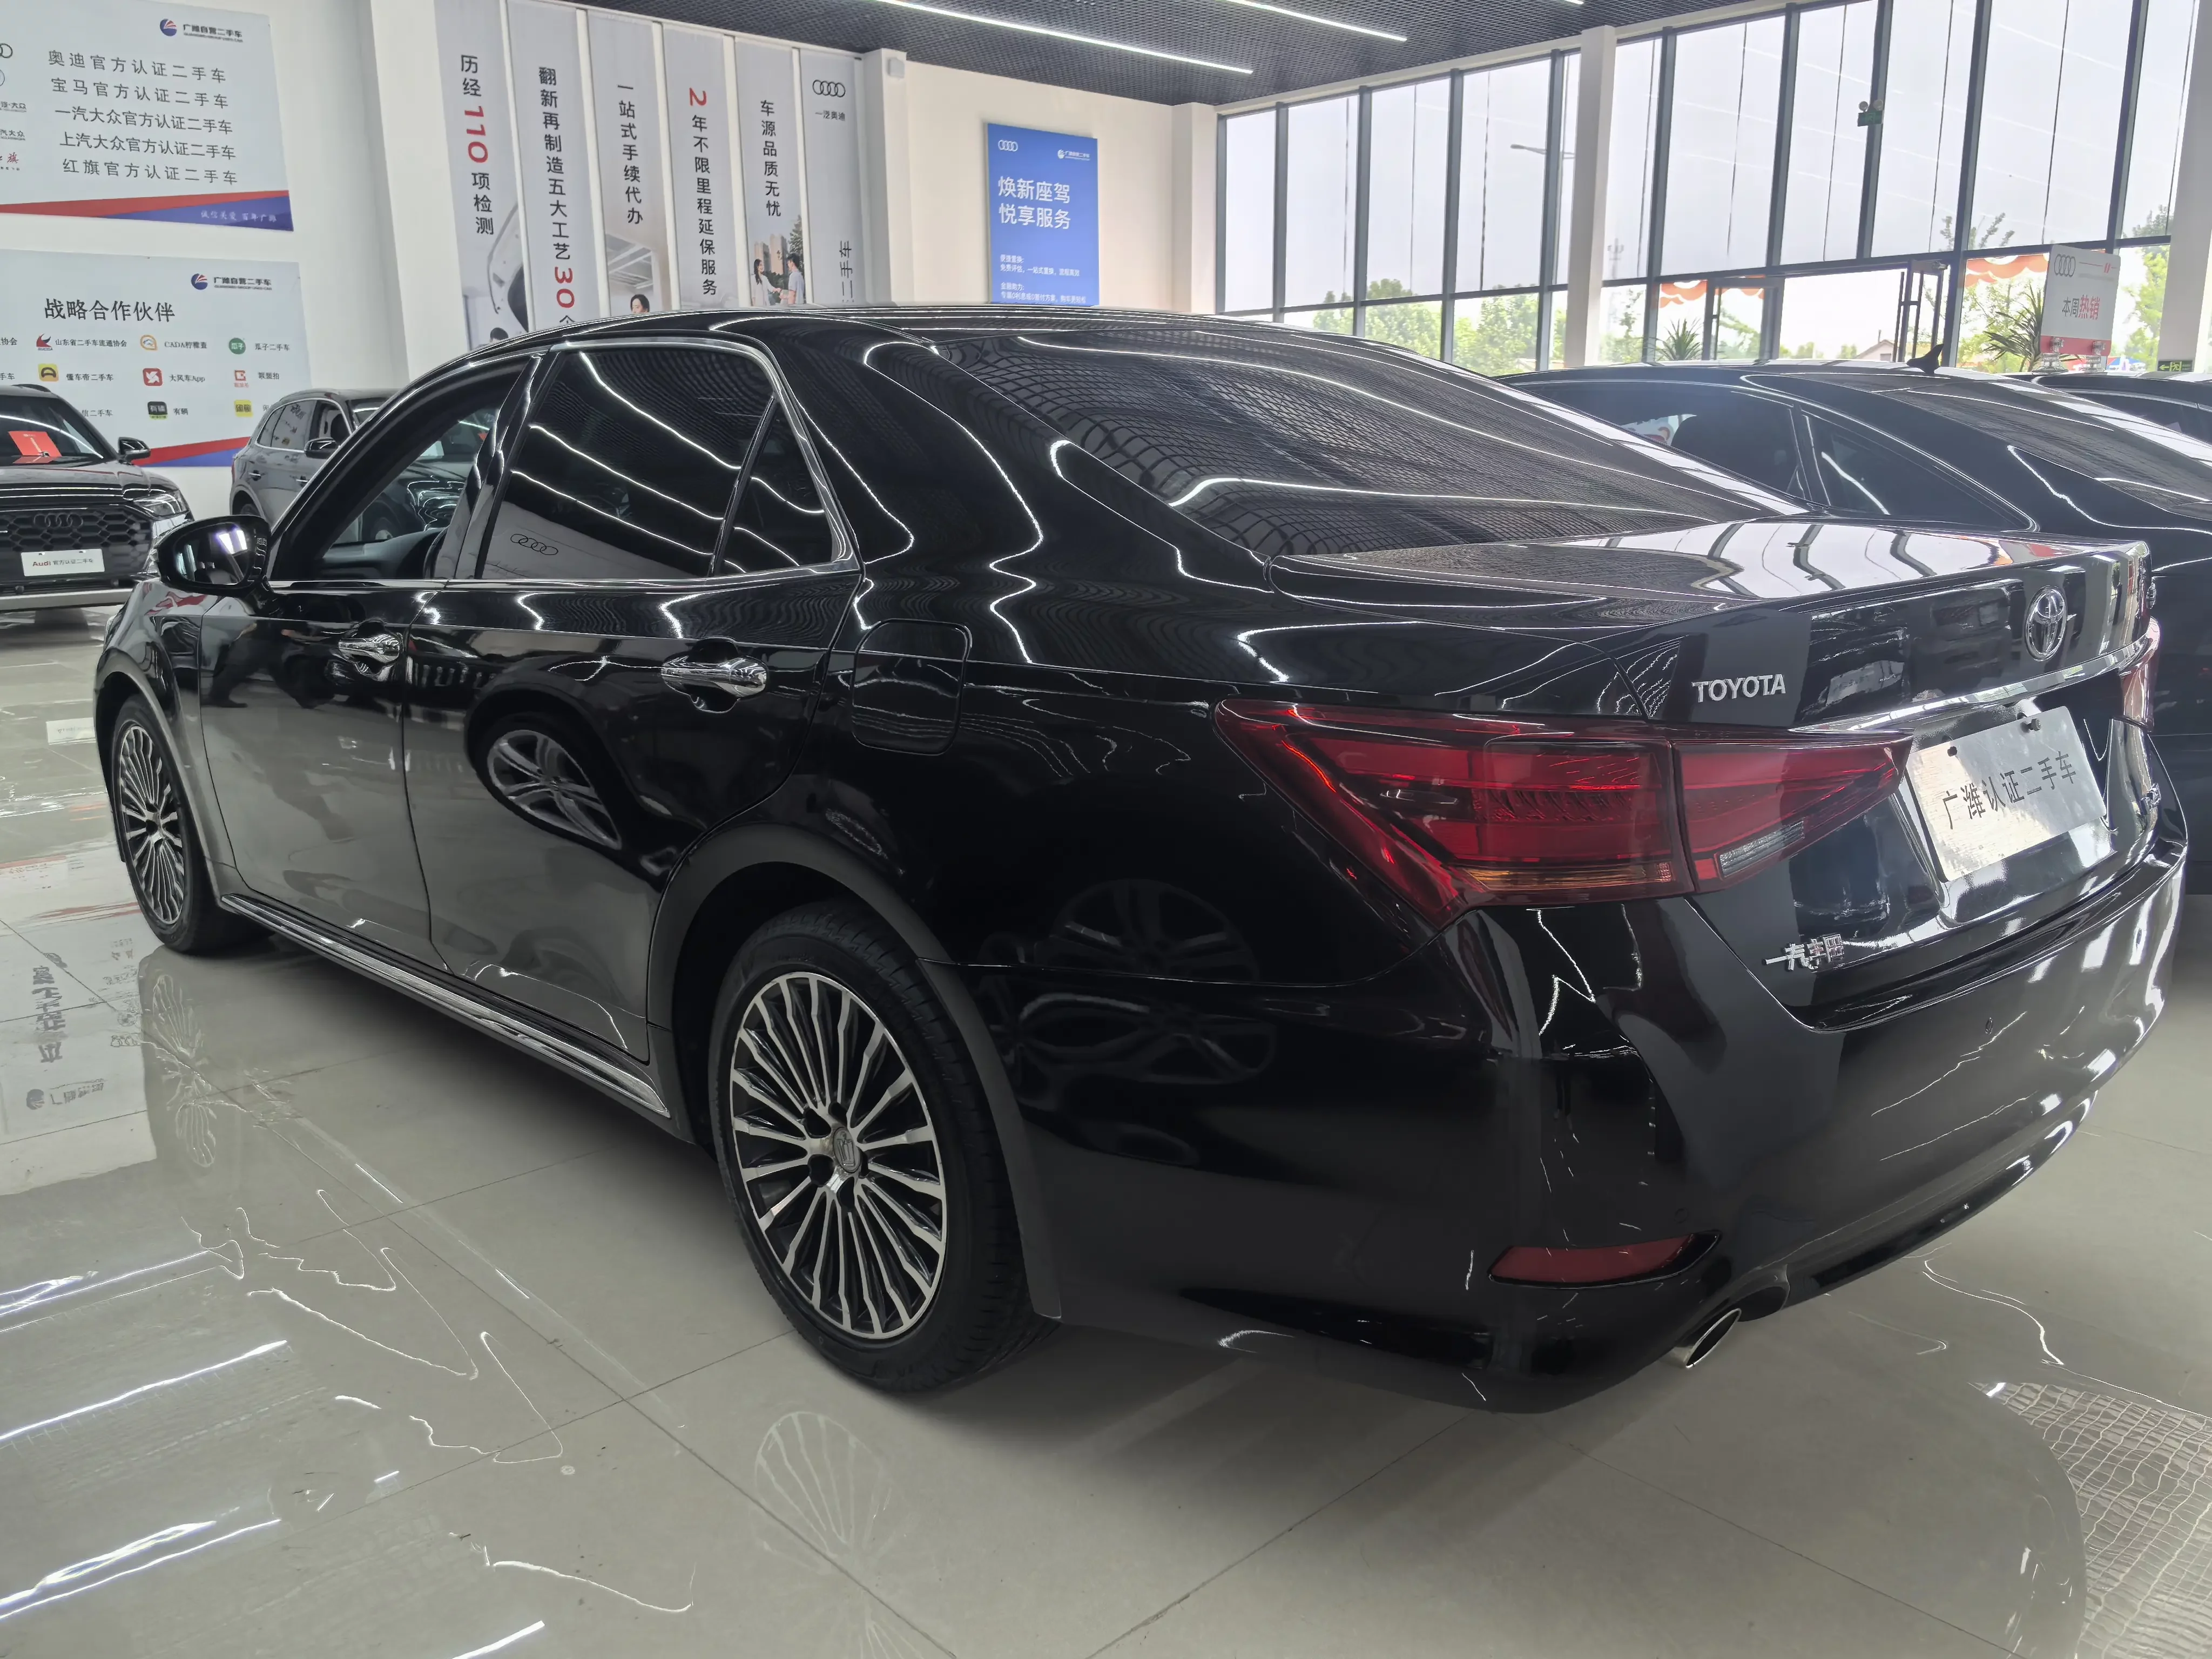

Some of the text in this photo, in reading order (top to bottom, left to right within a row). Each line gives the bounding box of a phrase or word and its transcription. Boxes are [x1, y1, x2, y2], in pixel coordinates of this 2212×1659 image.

[49, 50, 226, 83] 奥迪官方认证二手车
[51, 78, 228, 109] 宝马官方认证二手车
[55, 105, 233, 135] 一汽大众官方认证二手车
[59, 131, 237, 160] 上汽大众官方认证二手车
[461, 55, 494, 235] 历经110项检测
[617, 84, 643, 225] 一站式手续代办
[760, 100, 781, 217] 车源品质无忧
[63, 158, 238, 185] 红旗官方认证二手车
[689, 87, 717, 295] 2年不限里程延保服务
[998, 176, 1071, 204] 焕新座驾
[999, 202, 1071, 230] 悦享服务
[839, 240, 853, 302] 二手车
[44, 298, 175, 322] 战略合作伙伴
[2061, 294, 2100, 320] 本周热销
[0, 338, 18, 346] 协会
[254, 343, 291, 351] 瓜子二手车
[1691, 674, 1786, 703] TOYOTA
[1942, 751, 2076, 830] 广潍认证二手车
